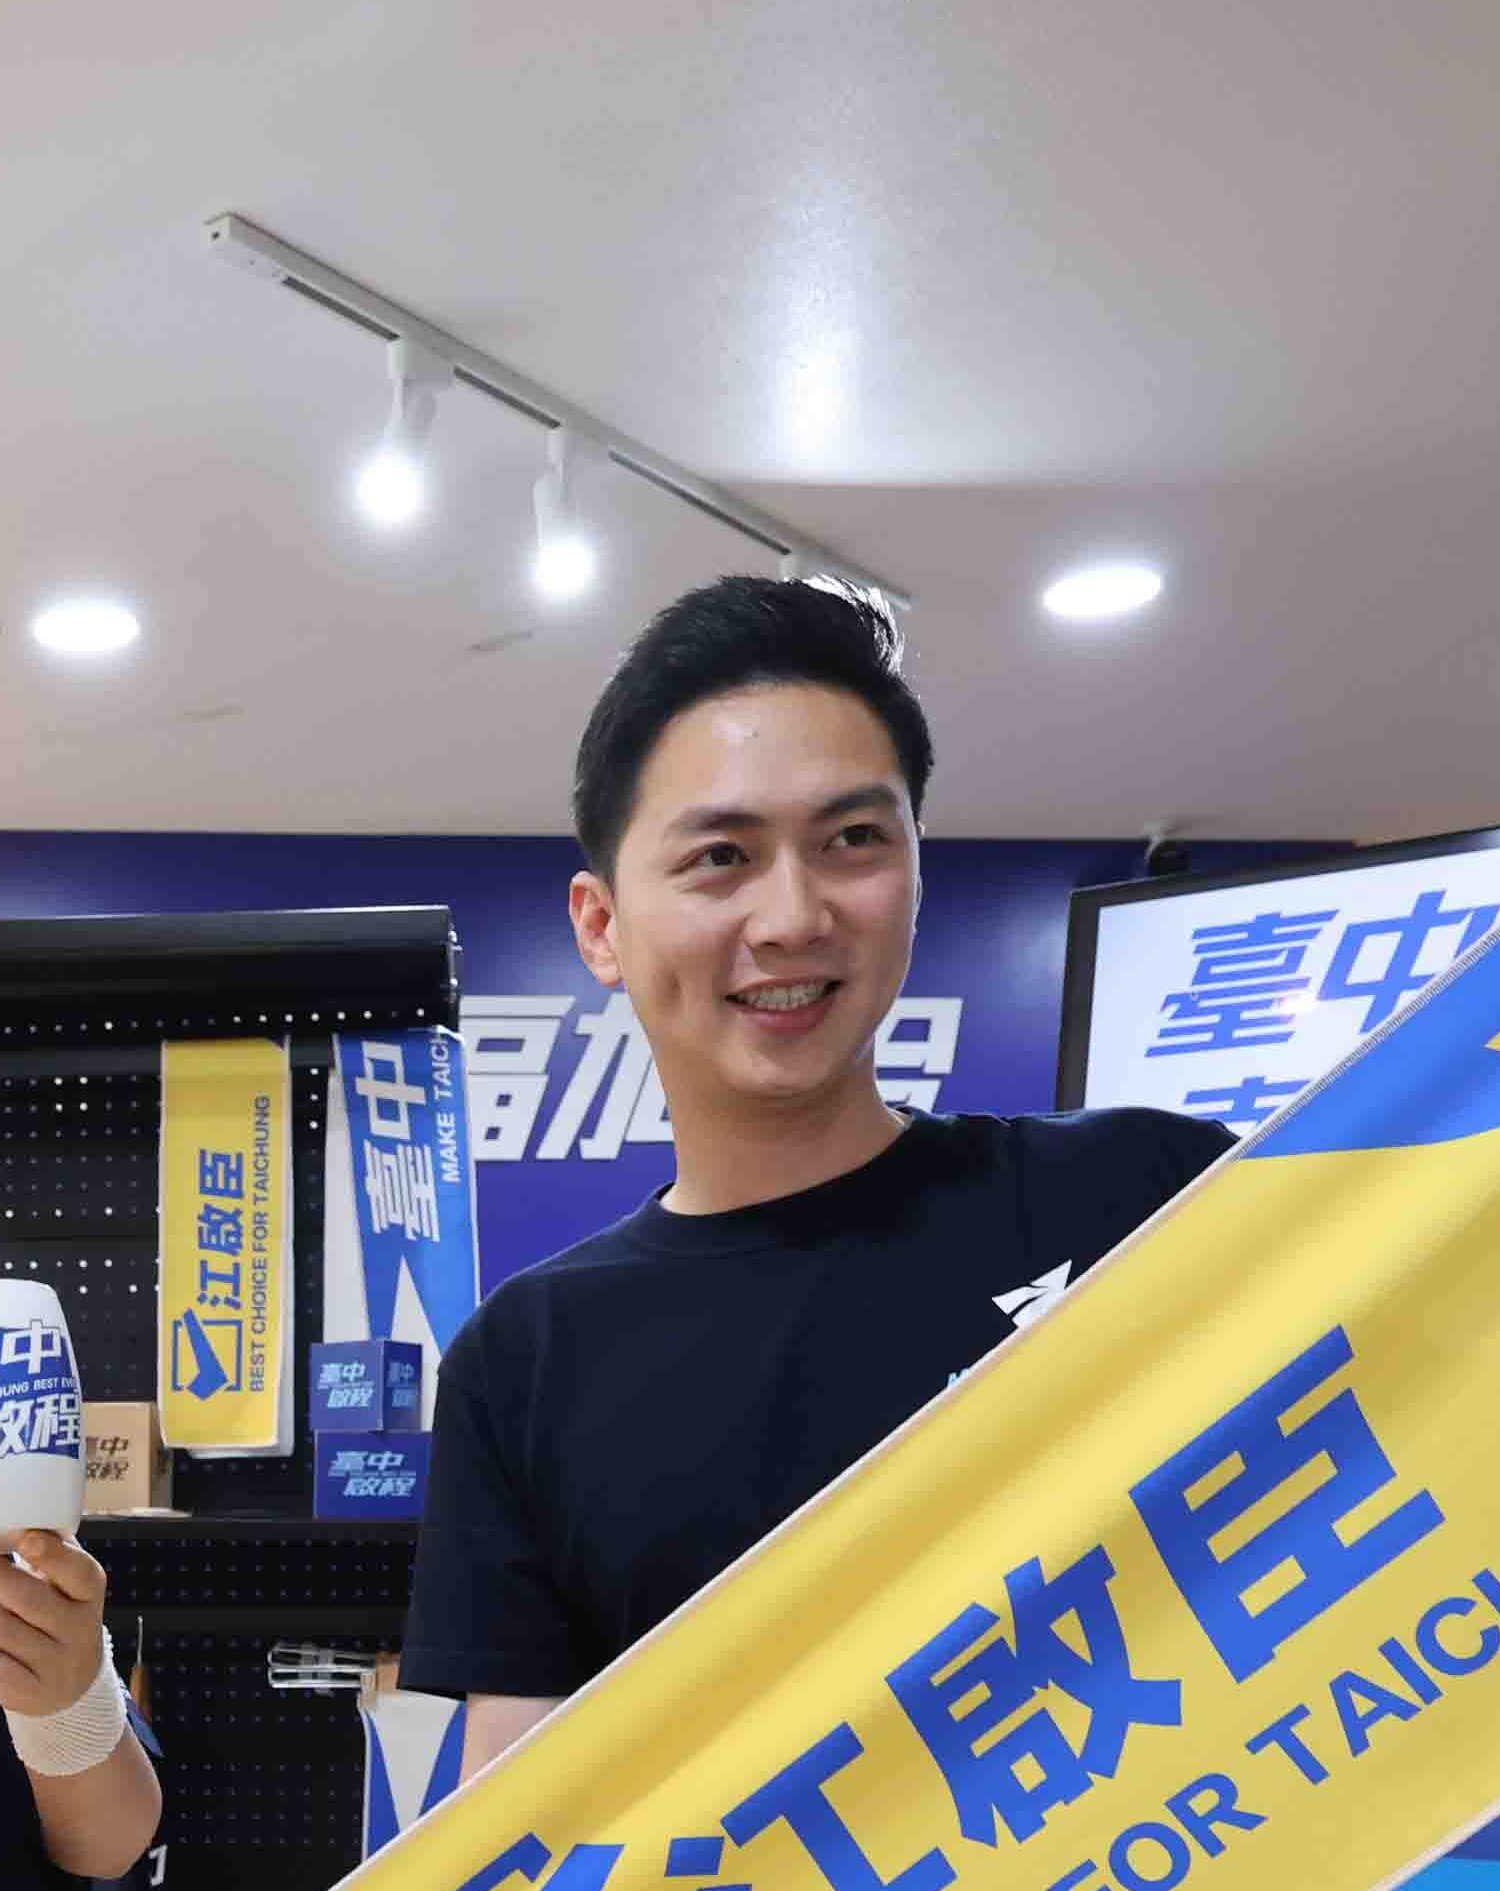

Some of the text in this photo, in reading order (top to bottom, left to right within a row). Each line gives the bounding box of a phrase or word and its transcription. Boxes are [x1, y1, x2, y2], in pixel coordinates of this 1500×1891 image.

[355, 1040, 440, 1242] 臺中
[435, 1111, 462, 1184] MAKE
[197, 1149, 245, 1310] 江啟臣
[248, 1096, 271, 1392] BEST CHOICE FOR TAICHUNG
[33, 1377, 58, 1391] BEST
